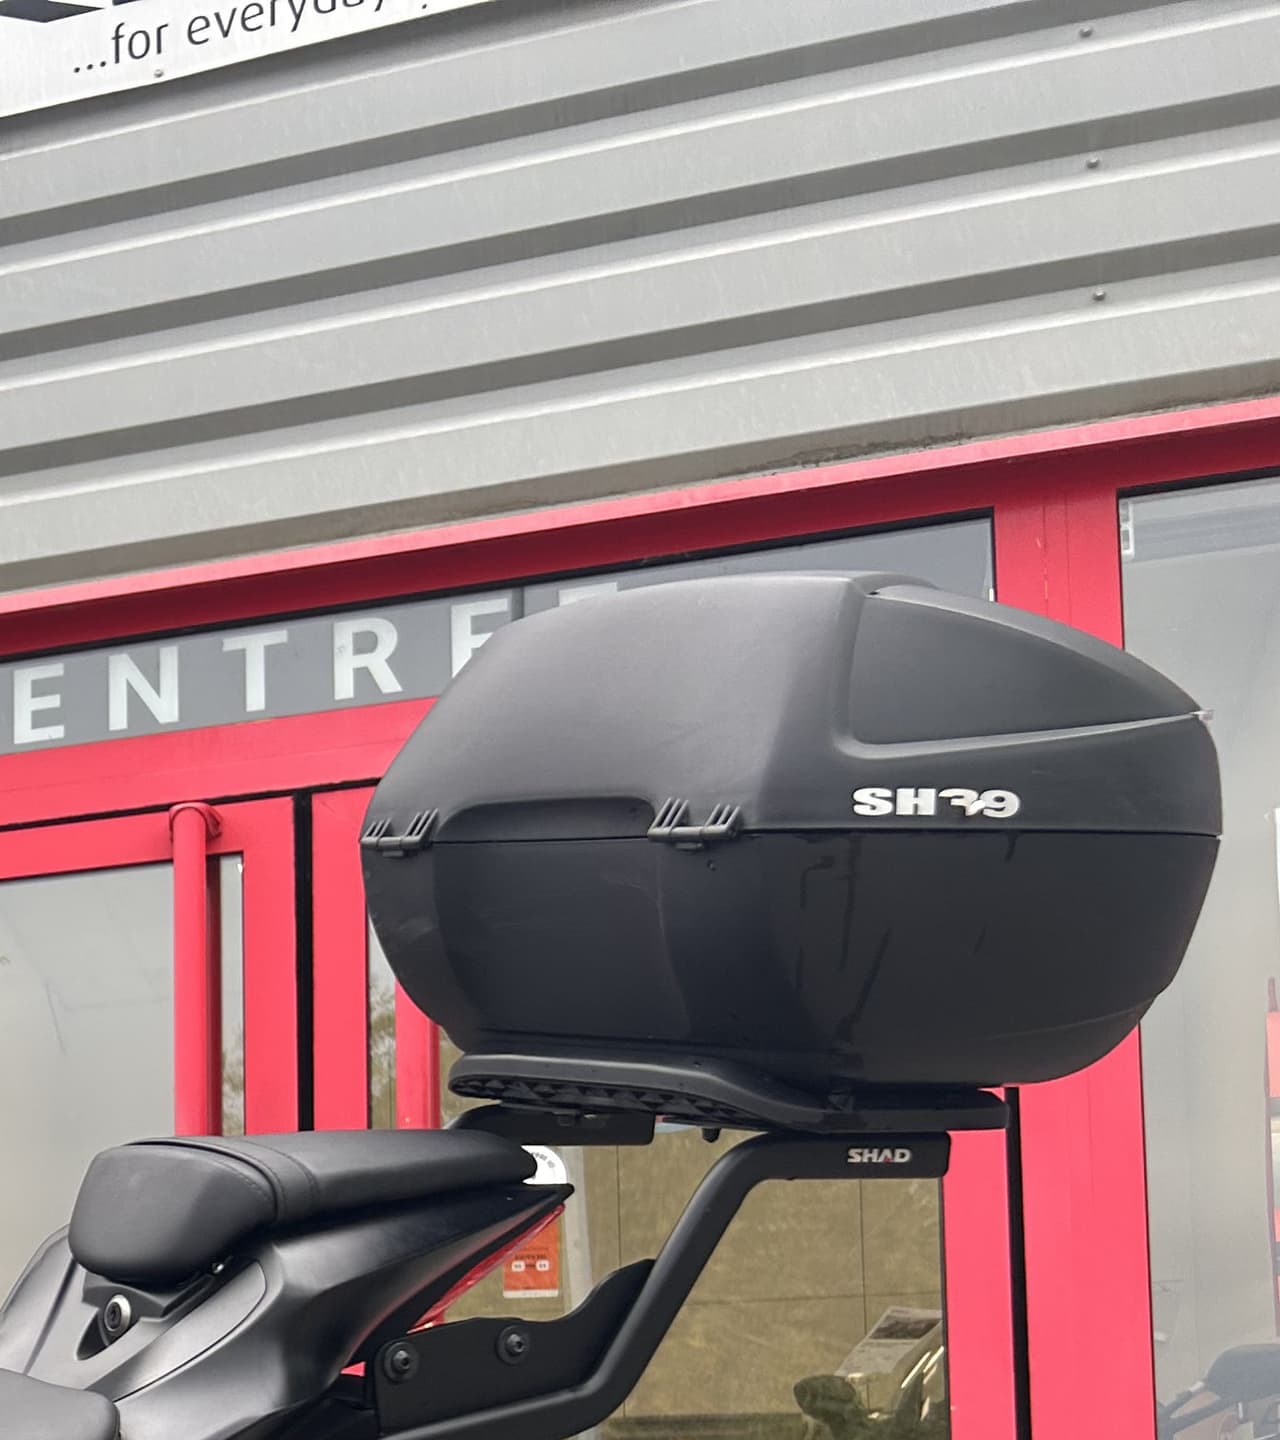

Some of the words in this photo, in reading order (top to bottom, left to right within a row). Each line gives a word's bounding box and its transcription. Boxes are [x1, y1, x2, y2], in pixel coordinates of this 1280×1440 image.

[186, 0, 383, 46] every
[11, 577, 618, 745] ENTRE
[852, 787, 1021, 818] SH39
[847, 1147, 912, 1163] SHAD
